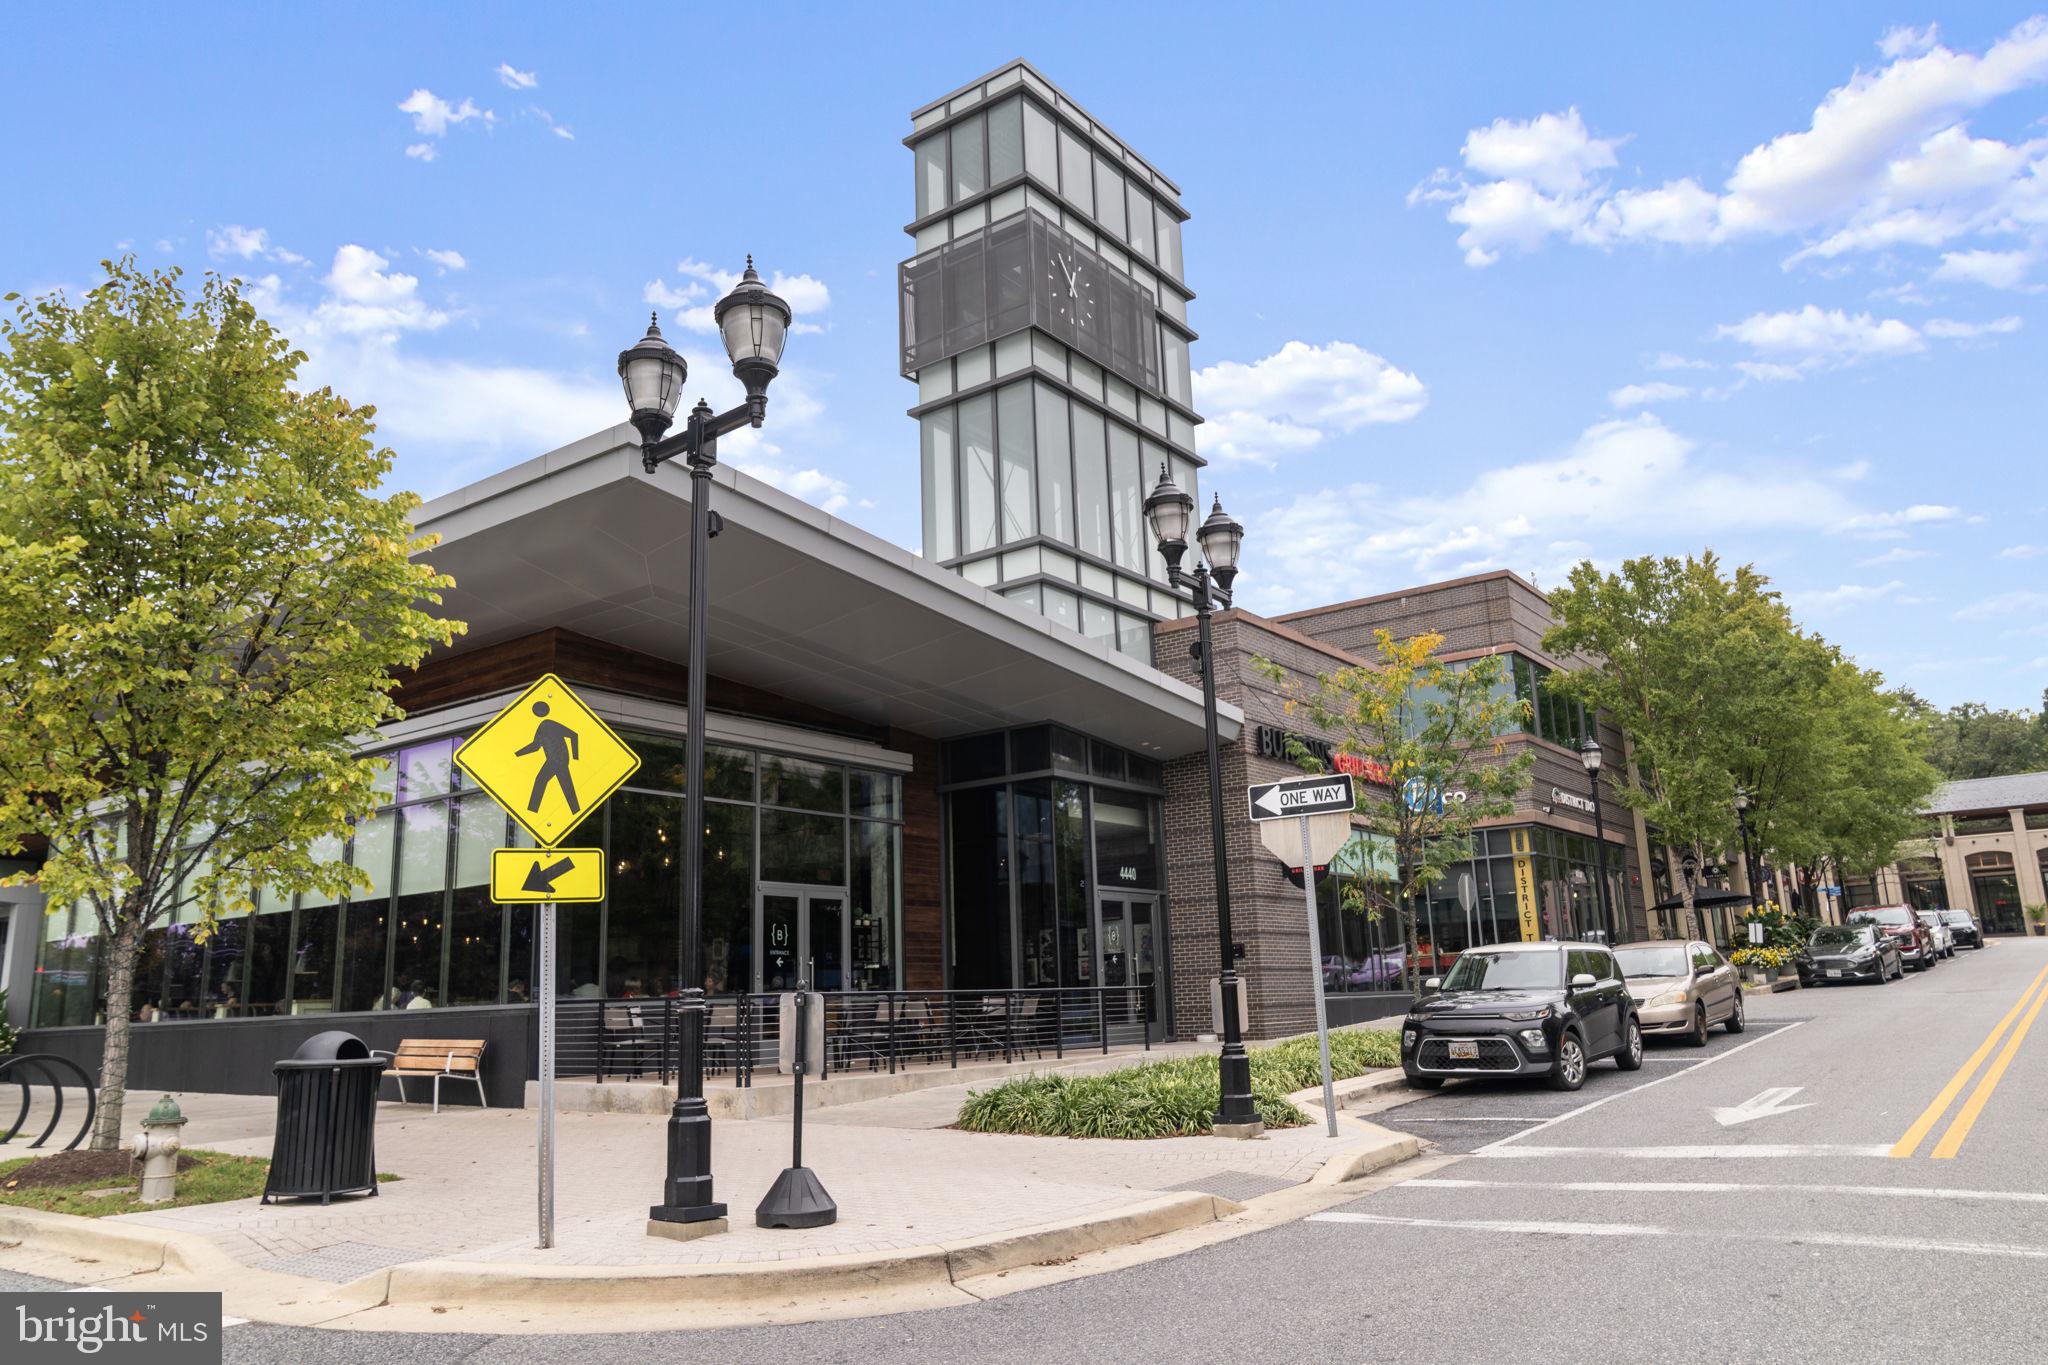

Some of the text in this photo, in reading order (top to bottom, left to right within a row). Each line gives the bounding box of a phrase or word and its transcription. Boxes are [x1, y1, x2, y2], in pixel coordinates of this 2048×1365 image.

[1257, 726, 1334, 771] BUONS
[1280, 786, 1341, 806] ONE WAY
[1119, 866, 1137, 880] 4440
[1517, 860, 1532, 928] DISTRICT
